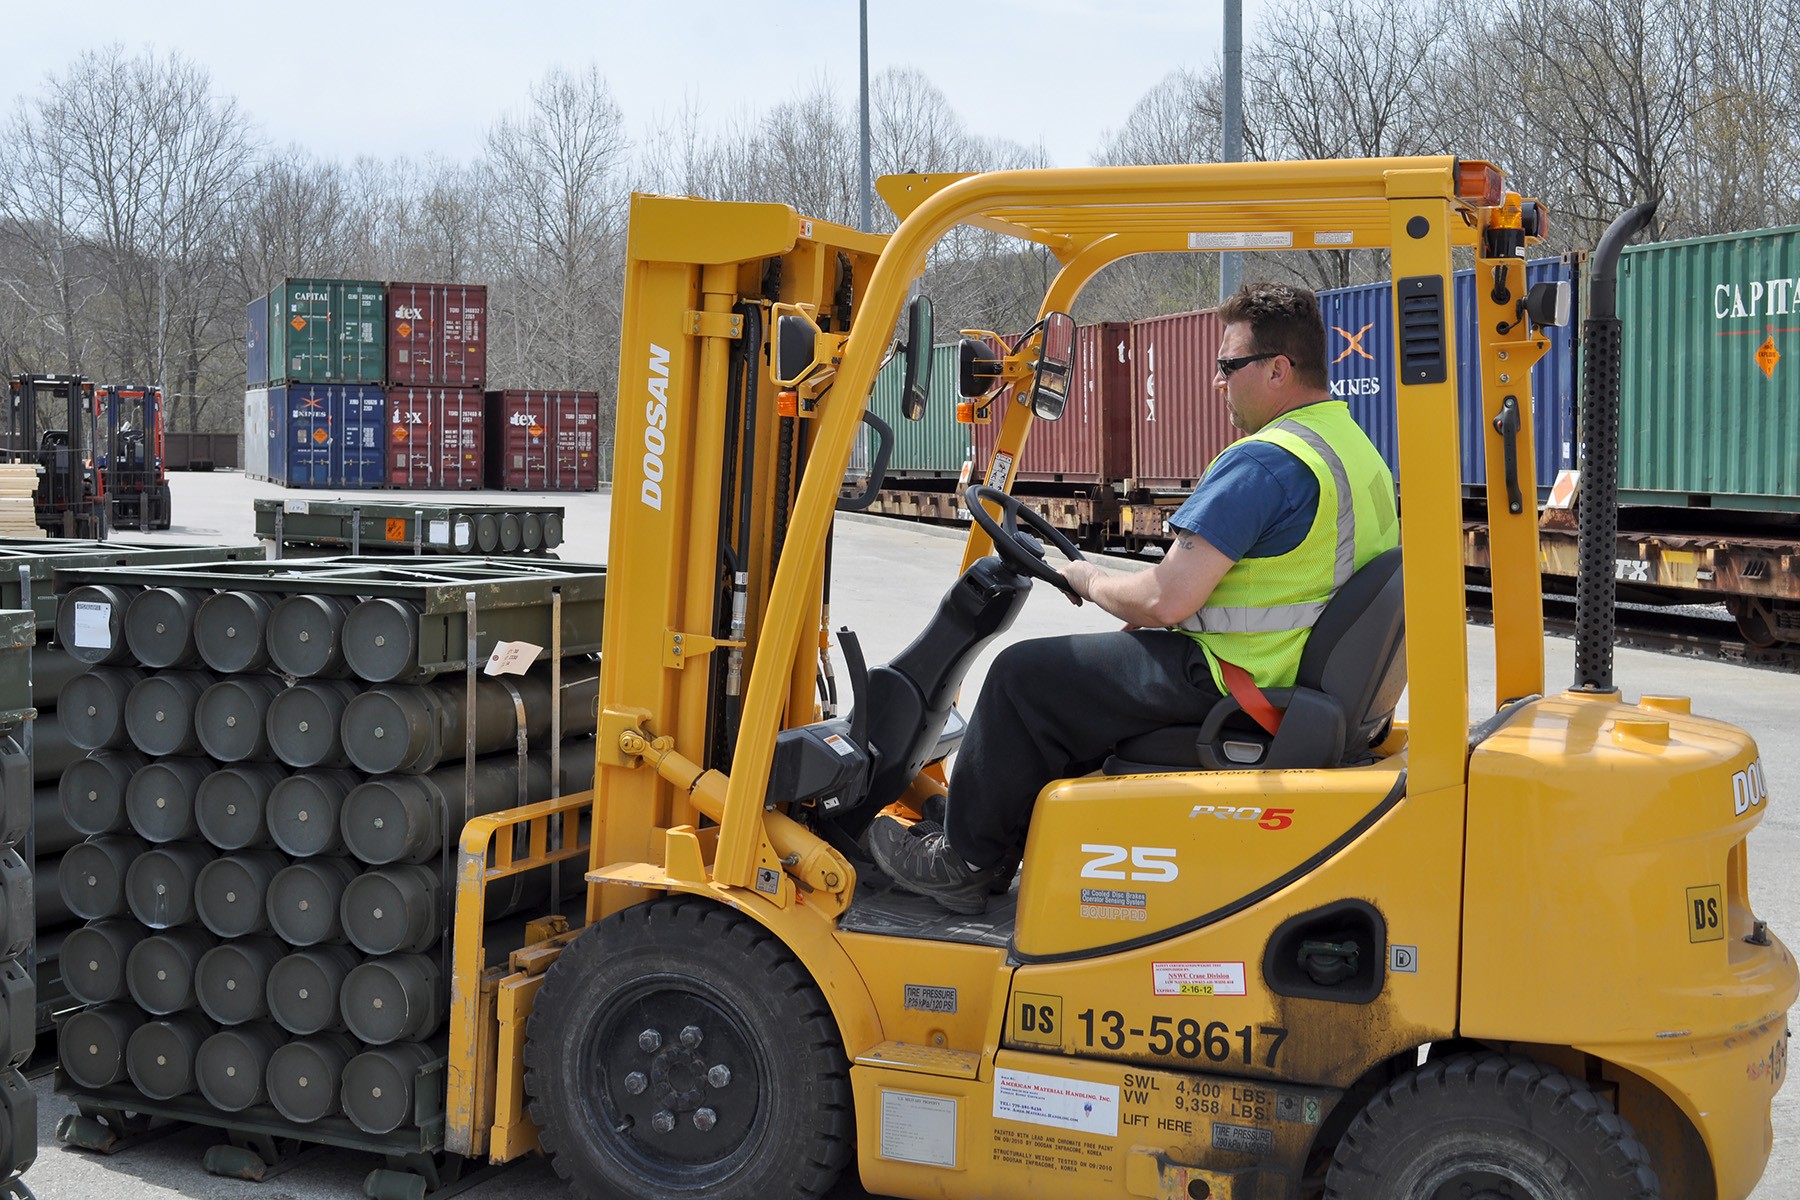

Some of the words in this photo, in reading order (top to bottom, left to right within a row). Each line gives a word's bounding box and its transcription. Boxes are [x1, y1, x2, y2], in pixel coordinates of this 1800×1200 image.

[1146, 342, 1156, 422] tex
[1329, 377, 1381, 396] XINES
[510, 411, 537, 426] tex
[641, 343, 670, 511] DOOSAN
[1187, 804, 1295, 831] PRO5
[1080, 843, 1179, 883] 25
[1081, 895, 1104, 904] Operator
[1105, 897, 1125, 906] Sensing
[1126, 898, 1146, 907] System
[1082, 888, 1091, 897] Oil
[1091, 889, 1110, 898] Cooled
[1111, 890, 1124, 899] Disc
[1126, 892, 1146, 901] Brakes
[1080, 905, 1147, 922] EQUIPPED
[1694, 897, 1719, 930] DS
[1206, 972, 1230, 980] Division
[907, 987, 920, 997] TIRE
[922, 988, 955, 1000] PRESSURE
[1181, 985, 1212, 994] 2-16-12
[1021, 1003, 1054, 1034] DS
[1077, 1008, 1289, 1068] 13-58617
[1123, 1073, 1160, 1091] SWL
[1176, 1080, 1221, 1099] 4,400
[1232, 1087, 1272, 1106] LBS.
[1123, 1089, 1149, 1105] VW
[1175, 1096, 1220, 1115] 9,358
[1231, 1103, 1271, 1121] LBS.
[1123, 1113, 1150, 1127] LIFT
[1157, 1117, 1193, 1133] HERE
[994, 1129, 1014, 1137] PAINTED
[1031, 1133, 1044, 1141] LEAD
[1057, 1138, 1081, 1147] CHROMATE
[1083, 1141, 1096, 1149] FREE
[1098, 1143, 1113, 1152] PAINT
[1214, 1125, 1230, 1138] TIRE
[1232, 1128, 1271, 1143] PRESSURE
[1002, 1137, 1023, 1145] 09/2010
[1034, 1141, 1053, 1149] DOOSAN
[1055, 1144, 1084, 1155] INFRACORE,
[1086, 1149, 1102, 1157] KOREA
[993, 1148, 1032, 1159] STRUCTURALLY
[1034, 1153, 1055, 1163] WEIGHT
[1057, 1157, 1078, 1166] TESTED
[1088, 1162, 1113, 1172] 09/2010
[1002, 1156, 1023, 1164] DOOSAN
[1025, 1159, 1058, 1170] INFRACORE,
[1060, 1165, 1078, 1173] KOREA
